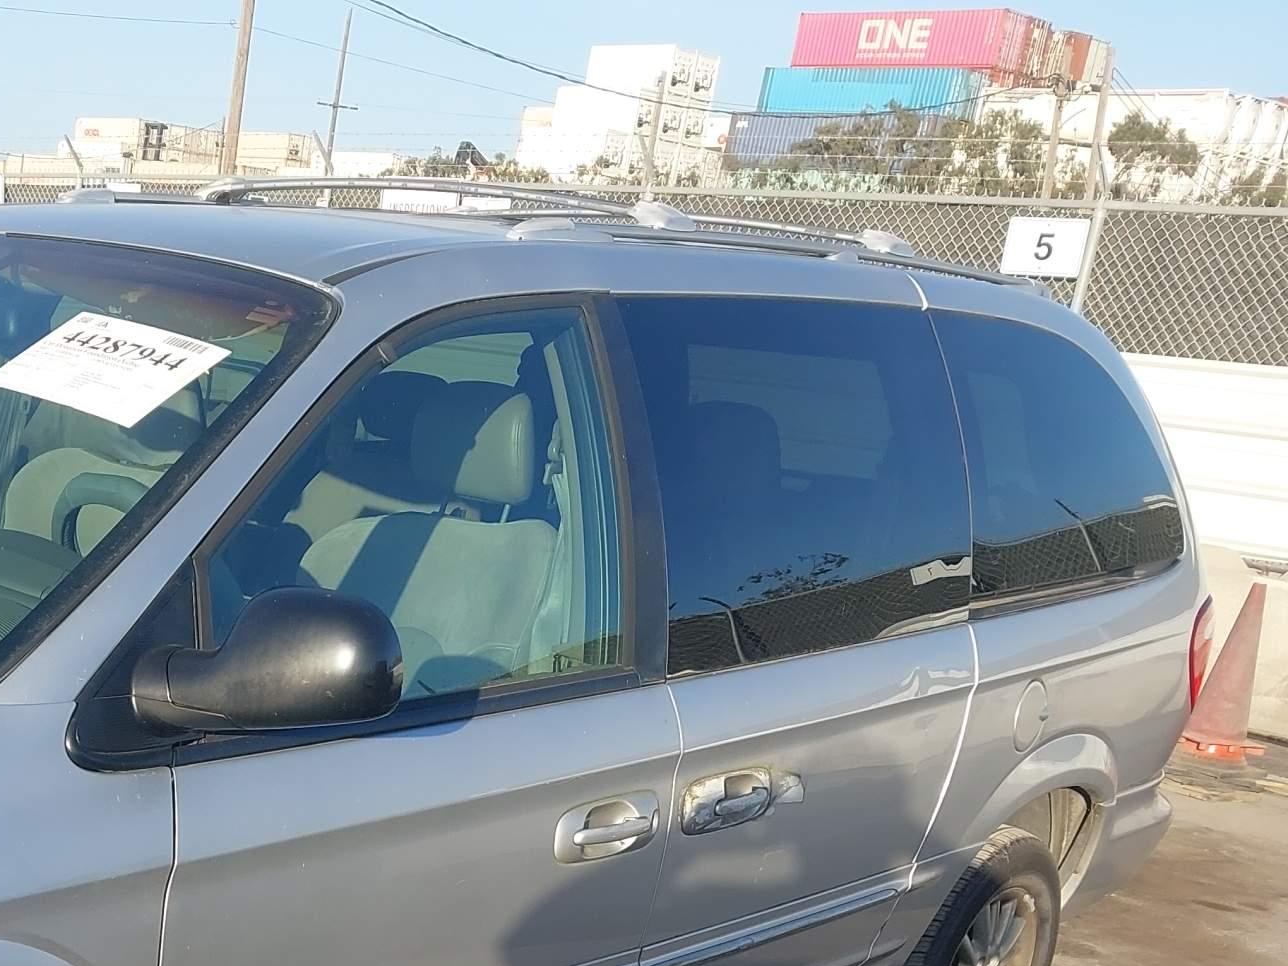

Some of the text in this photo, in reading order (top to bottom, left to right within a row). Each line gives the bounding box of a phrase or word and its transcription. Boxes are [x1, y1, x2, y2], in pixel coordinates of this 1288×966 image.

[856, 17, 933, 50] ONE
[1034, 233, 1055, 261] 5
[63, 331, 187, 371] 44287944
